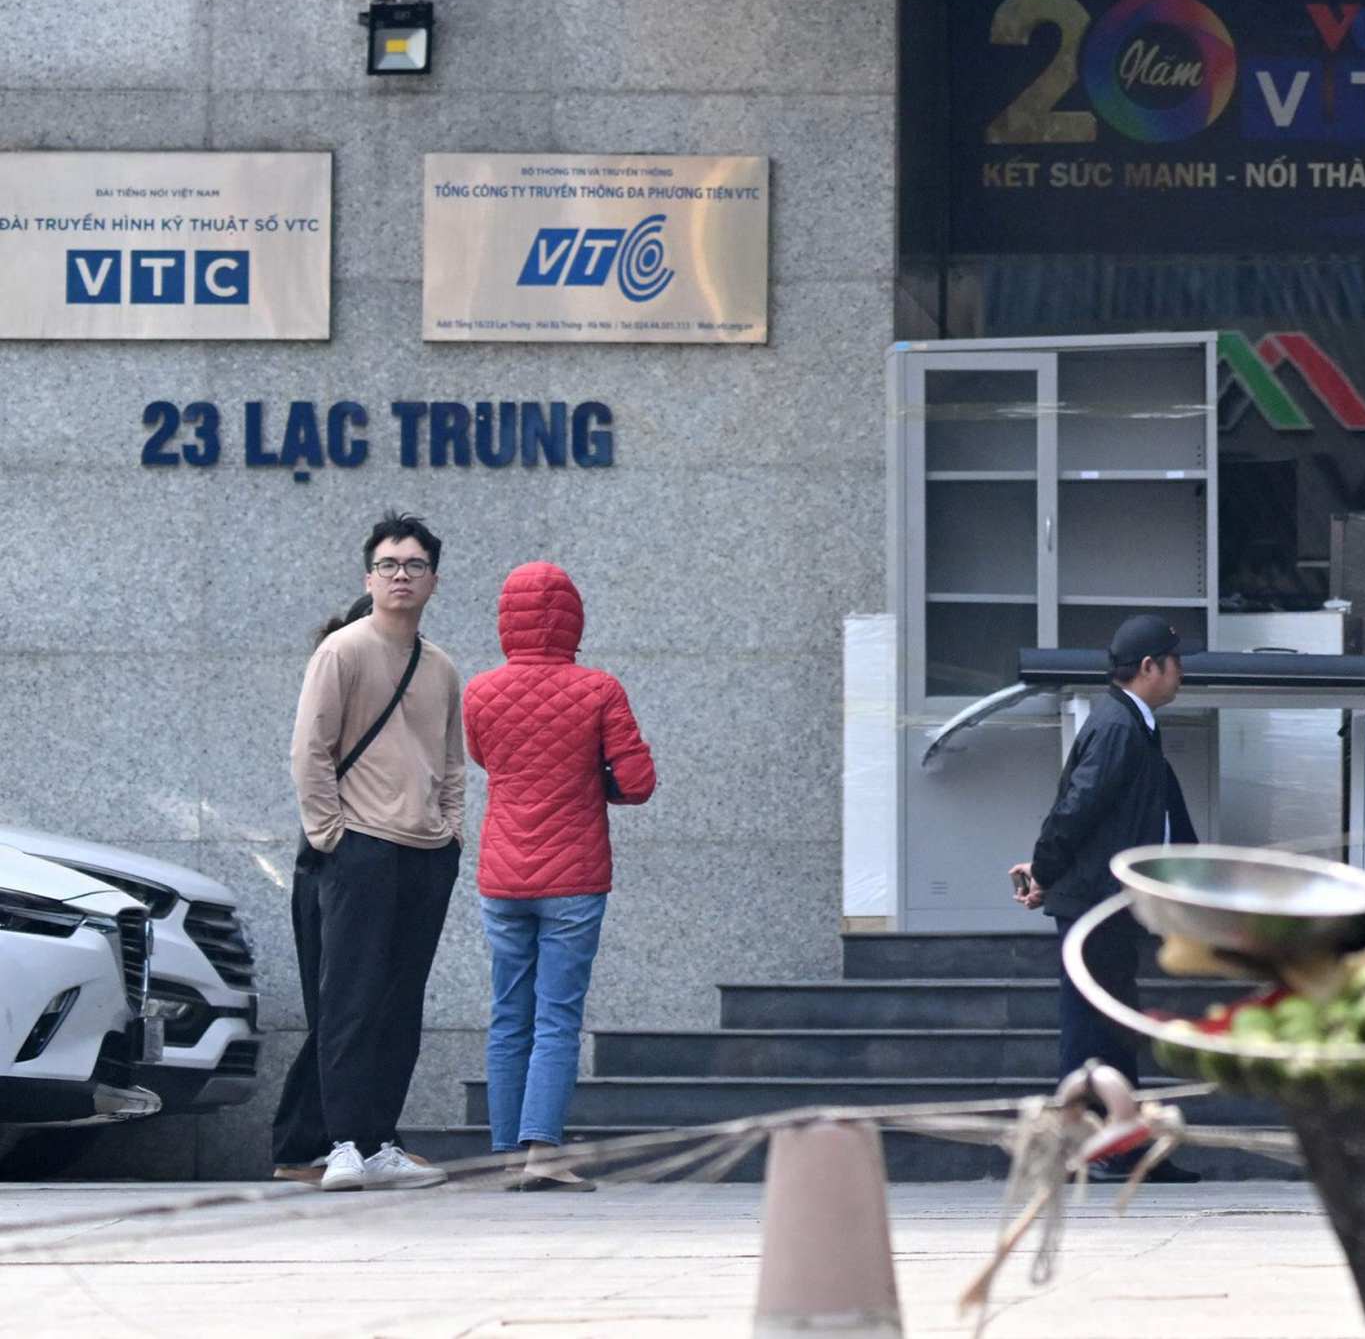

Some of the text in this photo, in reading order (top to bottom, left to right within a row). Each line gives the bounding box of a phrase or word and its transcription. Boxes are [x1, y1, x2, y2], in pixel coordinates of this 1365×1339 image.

[1119, 39, 1204, 90] Năm
[472, 184, 508, 198] CÔNG
[510, 186, 526, 198] TY
[580, 183, 625, 199] THÔNG
[627, 186, 645, 199] ĐA
[647, 185, 704, 199] PHƯƠNG
[735, 187, 760, 200] VTC
[981, 157, 1039, 189] KẾT
[1049, 157, 1113, 189] SỨC
[1124, 163, 1217, 192] MẠNH
[1245, 157, 1298, 189] NỐI
[0, 214, 29, 231] ĐÀI
[111, 214, 155, 231] HÌNH
[160, 215, 184, 231] KỸ
[189, 214, 249, 236] THUẬT
[254, 213, 280, 232] SỐ
[285, 218, 319, 232] VTC
[73, 255, 242, 299] VTC
[140, 400, 615, 483] 23 LẠC TRUNG
